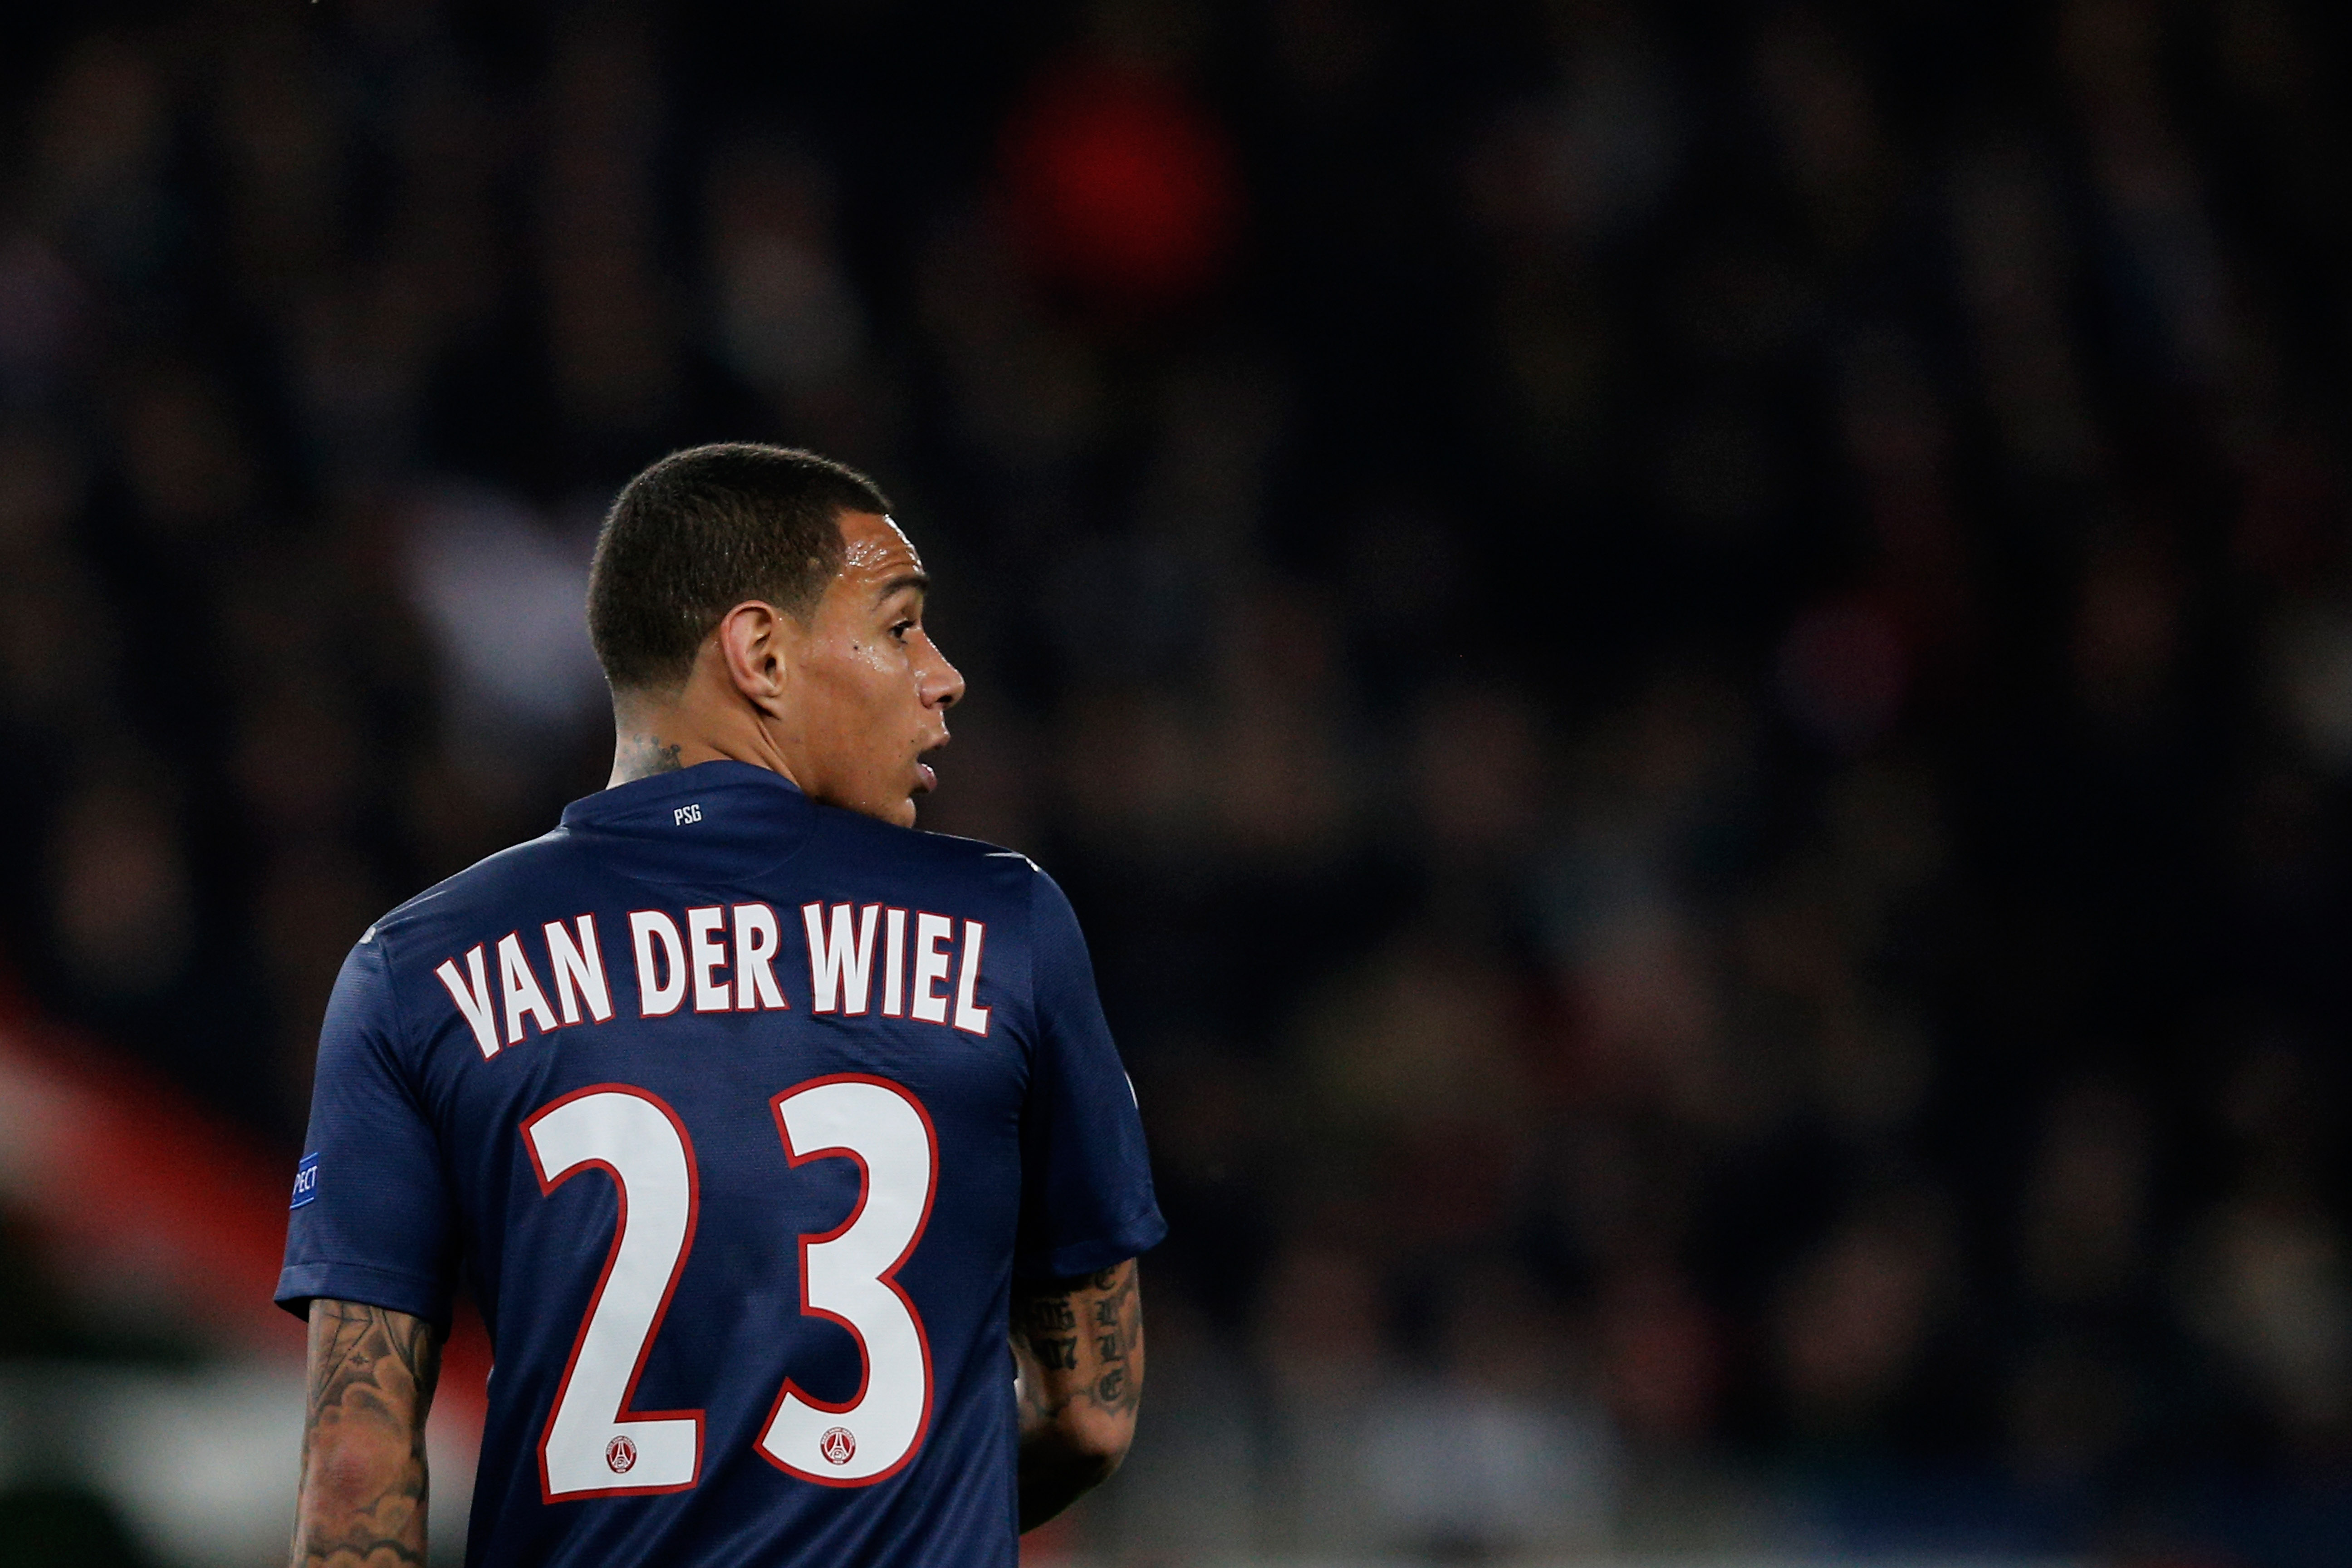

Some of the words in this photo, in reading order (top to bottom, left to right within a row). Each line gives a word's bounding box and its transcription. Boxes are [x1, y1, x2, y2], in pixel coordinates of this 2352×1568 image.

[674, 804, 702, 826] PSG
[434, 912, 615, 1061] VAN
[627, 901, 789, 1018] DER
[801, 900, 991, 1037] WIEL
[519, 1073, 938, 1504] 23
